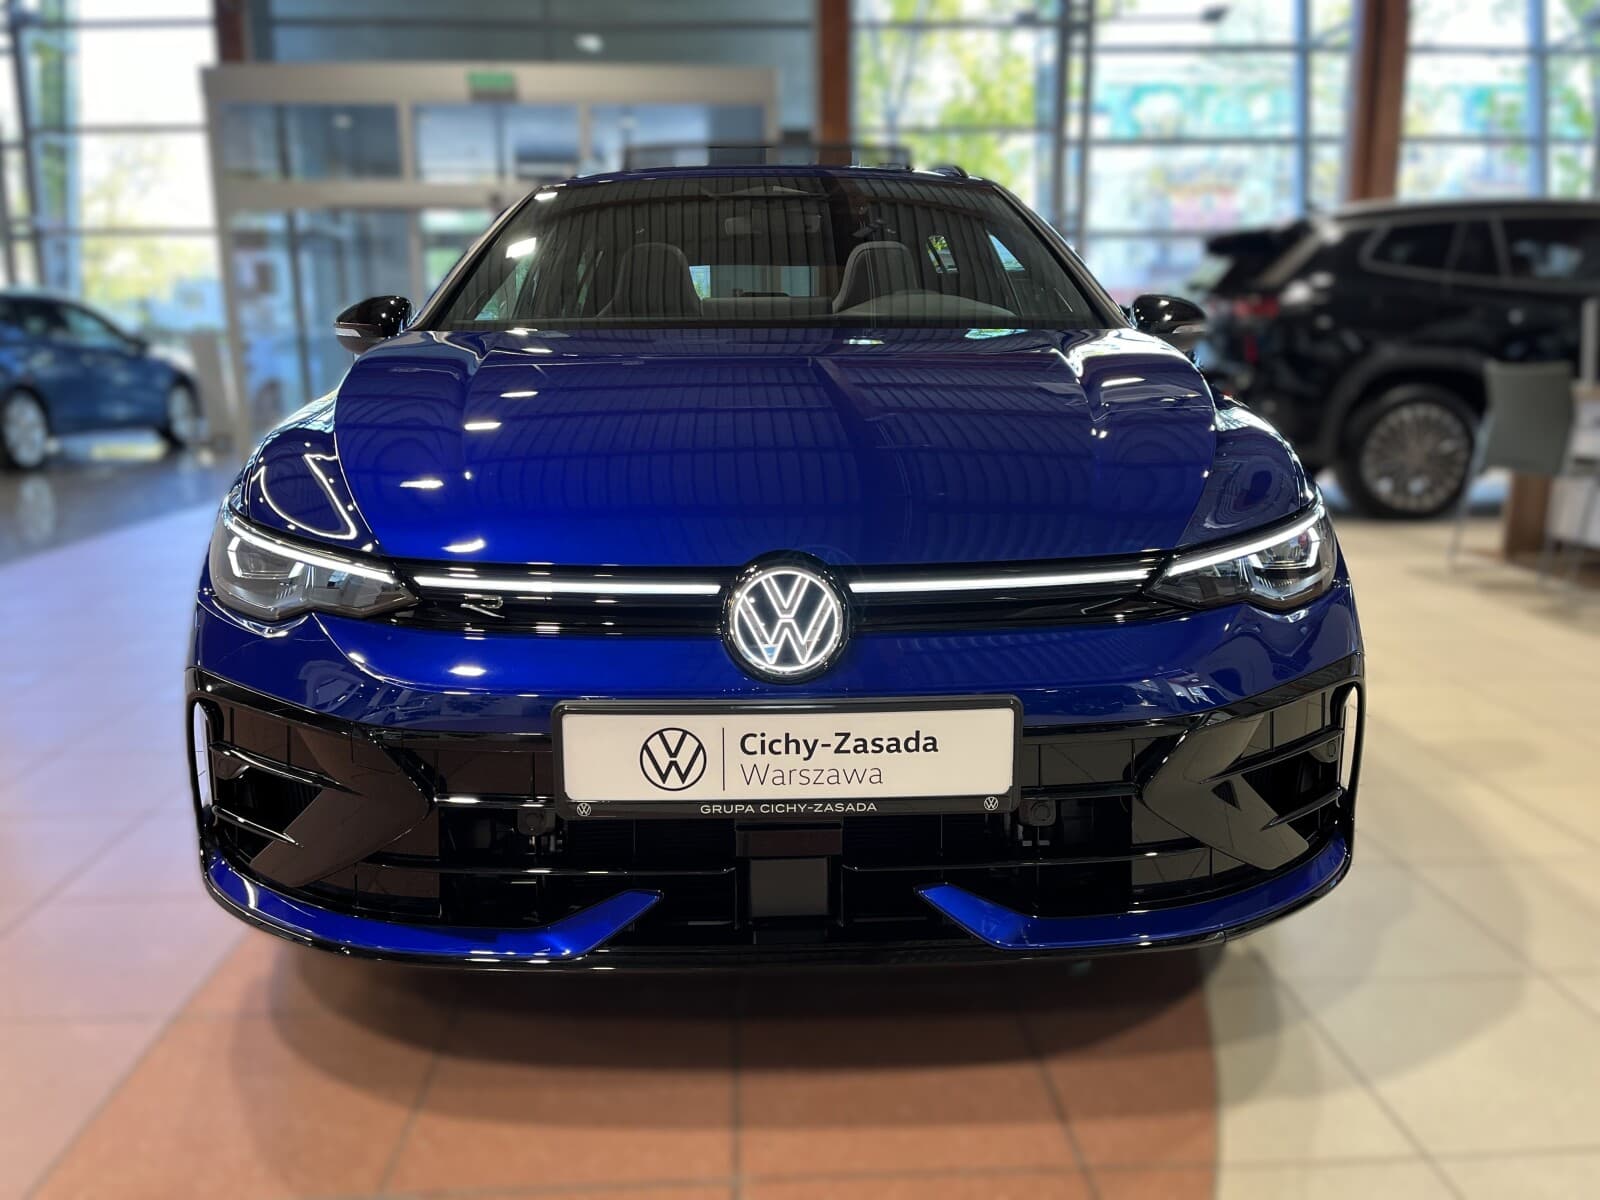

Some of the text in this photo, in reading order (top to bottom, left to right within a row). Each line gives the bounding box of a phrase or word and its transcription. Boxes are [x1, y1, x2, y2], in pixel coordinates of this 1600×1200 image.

[735, 569, 838, 671] VW
[640, 728, 707, 791] VW
[740, 730, 938, 761] Cichy-Zasada
[740, 763, 883, 786] Warszawa
[700, 802, 878, 815] GRUPA CICHY-ZASADA
